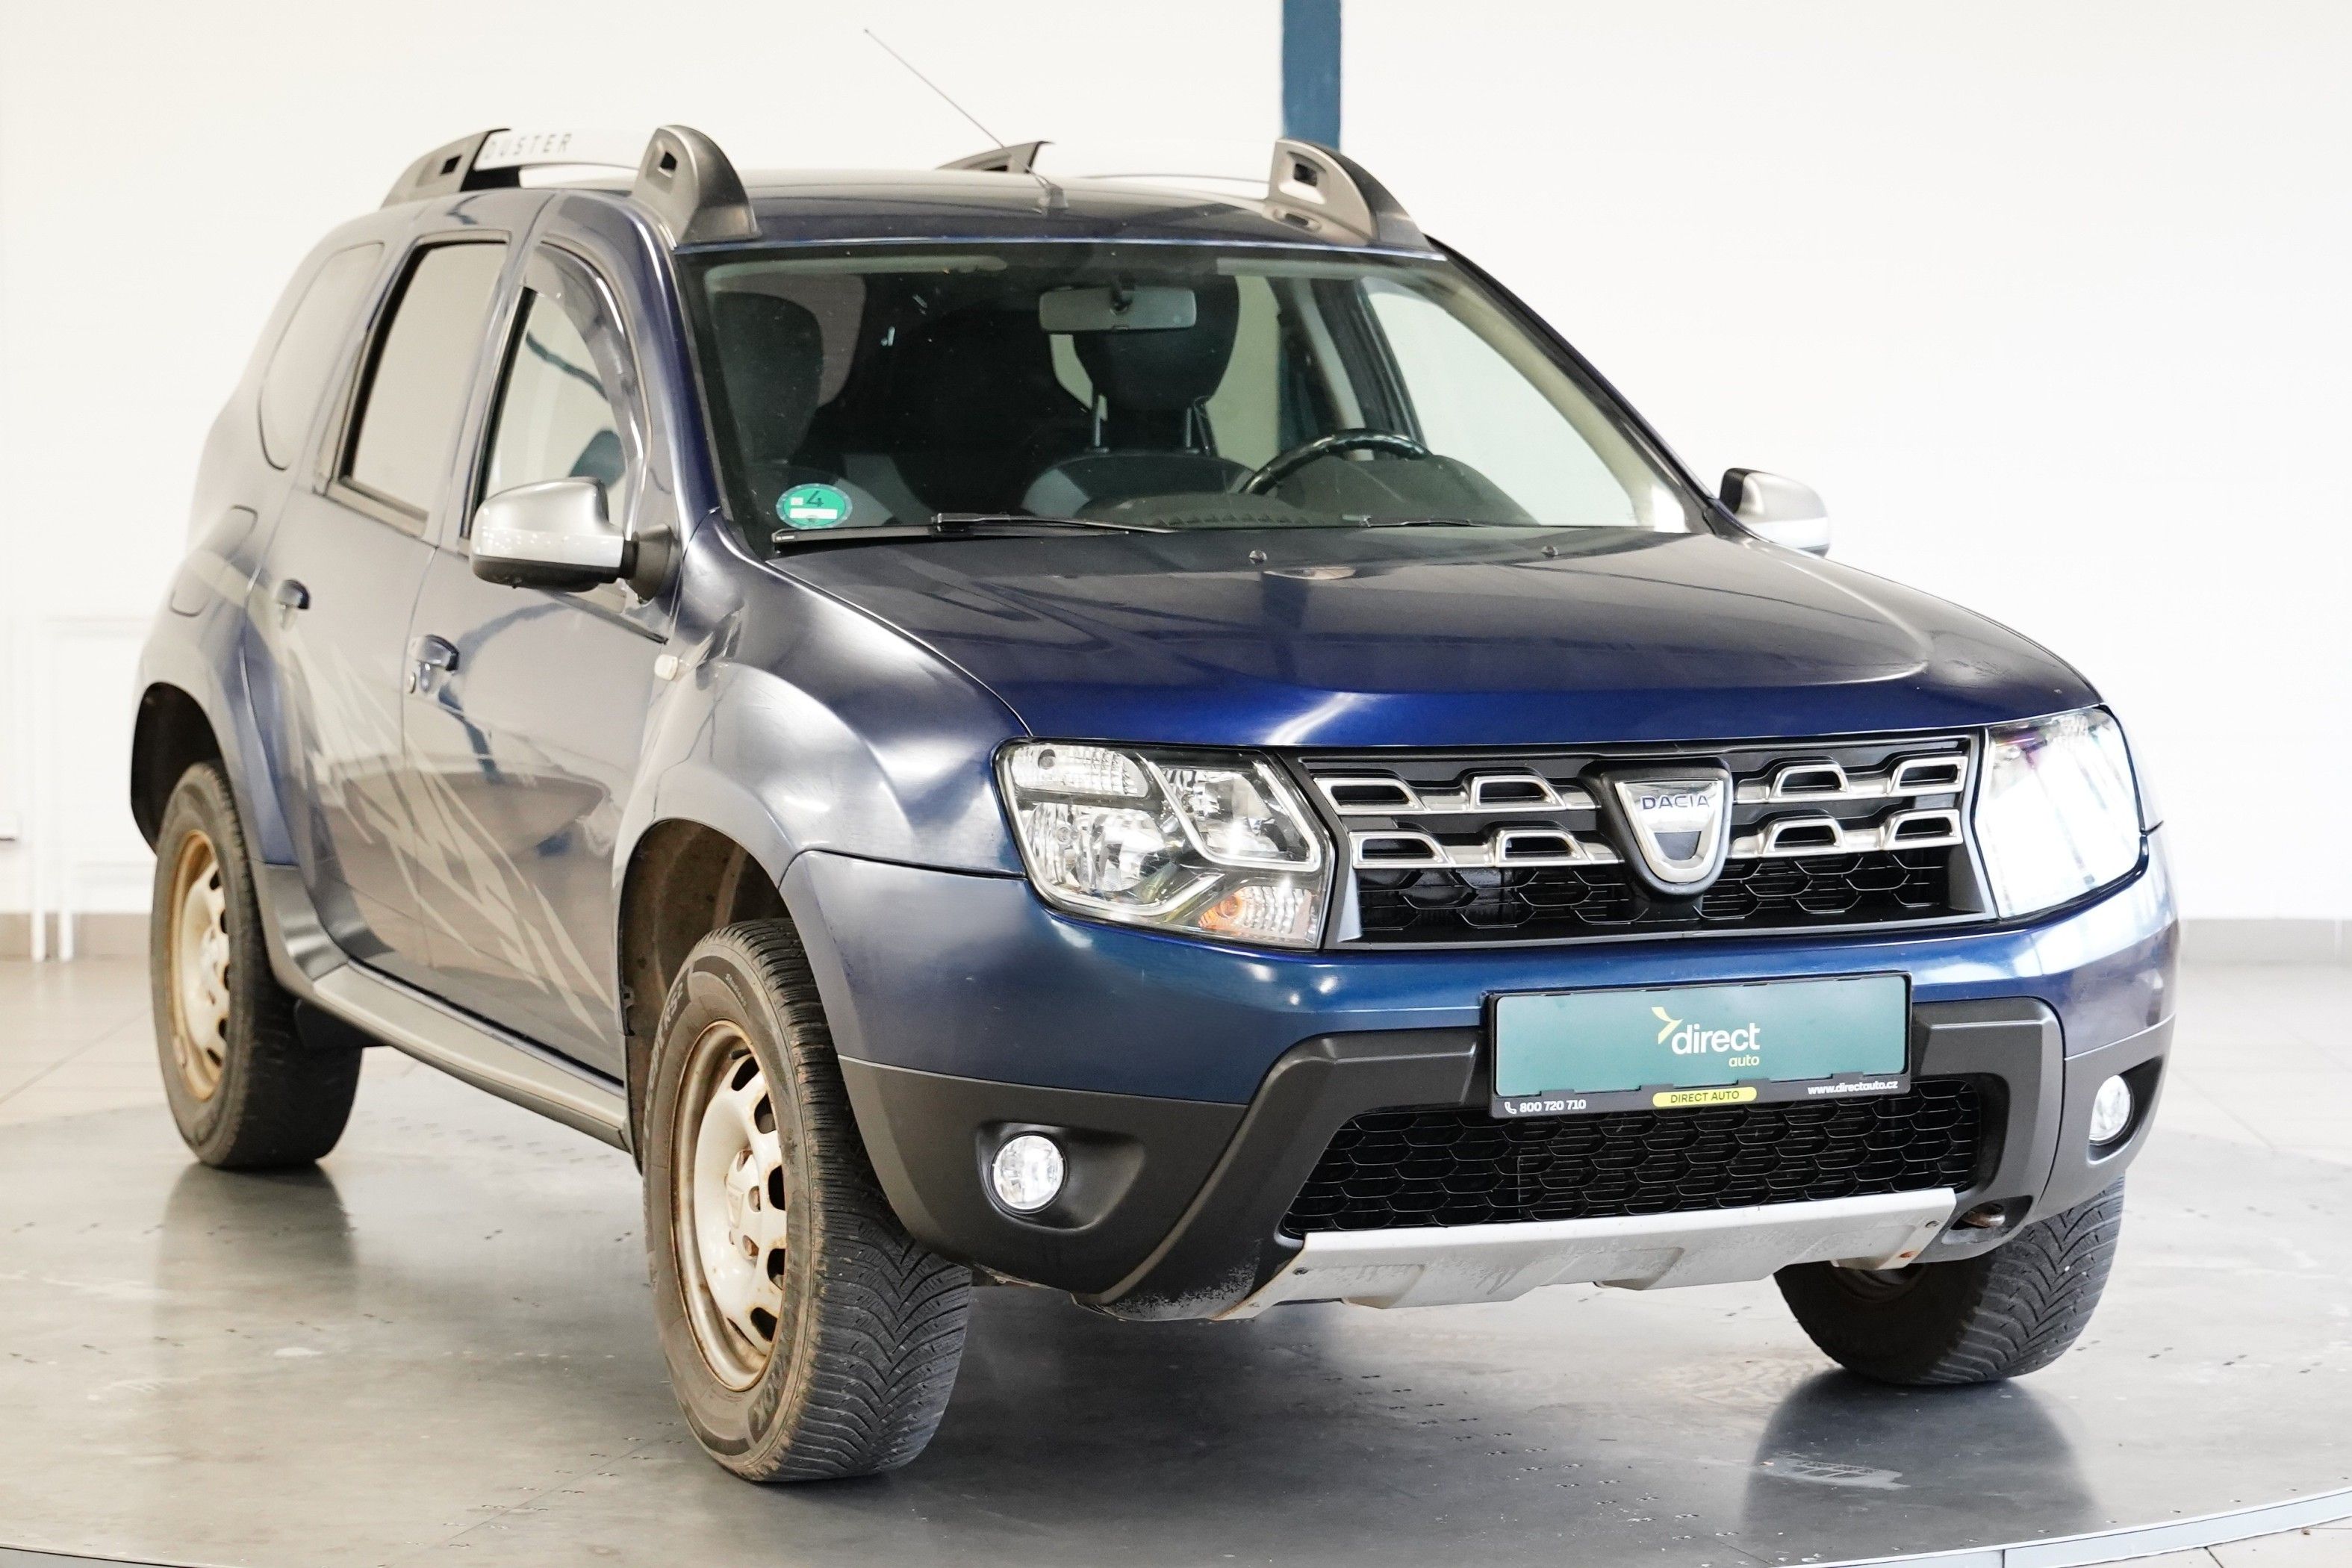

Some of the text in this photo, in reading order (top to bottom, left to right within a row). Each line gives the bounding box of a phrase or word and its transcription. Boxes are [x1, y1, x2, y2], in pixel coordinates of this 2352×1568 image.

[806, 490, 824, 508] 4
[1642, 794, 1711, 810] DACIA
[1671, 1022, 1761, 1055] direct
[1729, 1054, 1761, 1068] auto
[1807, 1080, 1899, 1095] www.directauto.cz
[1670, 1090, 1740, 1104] DIRECT AUTO
[1519, 1099, 1587, 1113] 800 720 710
